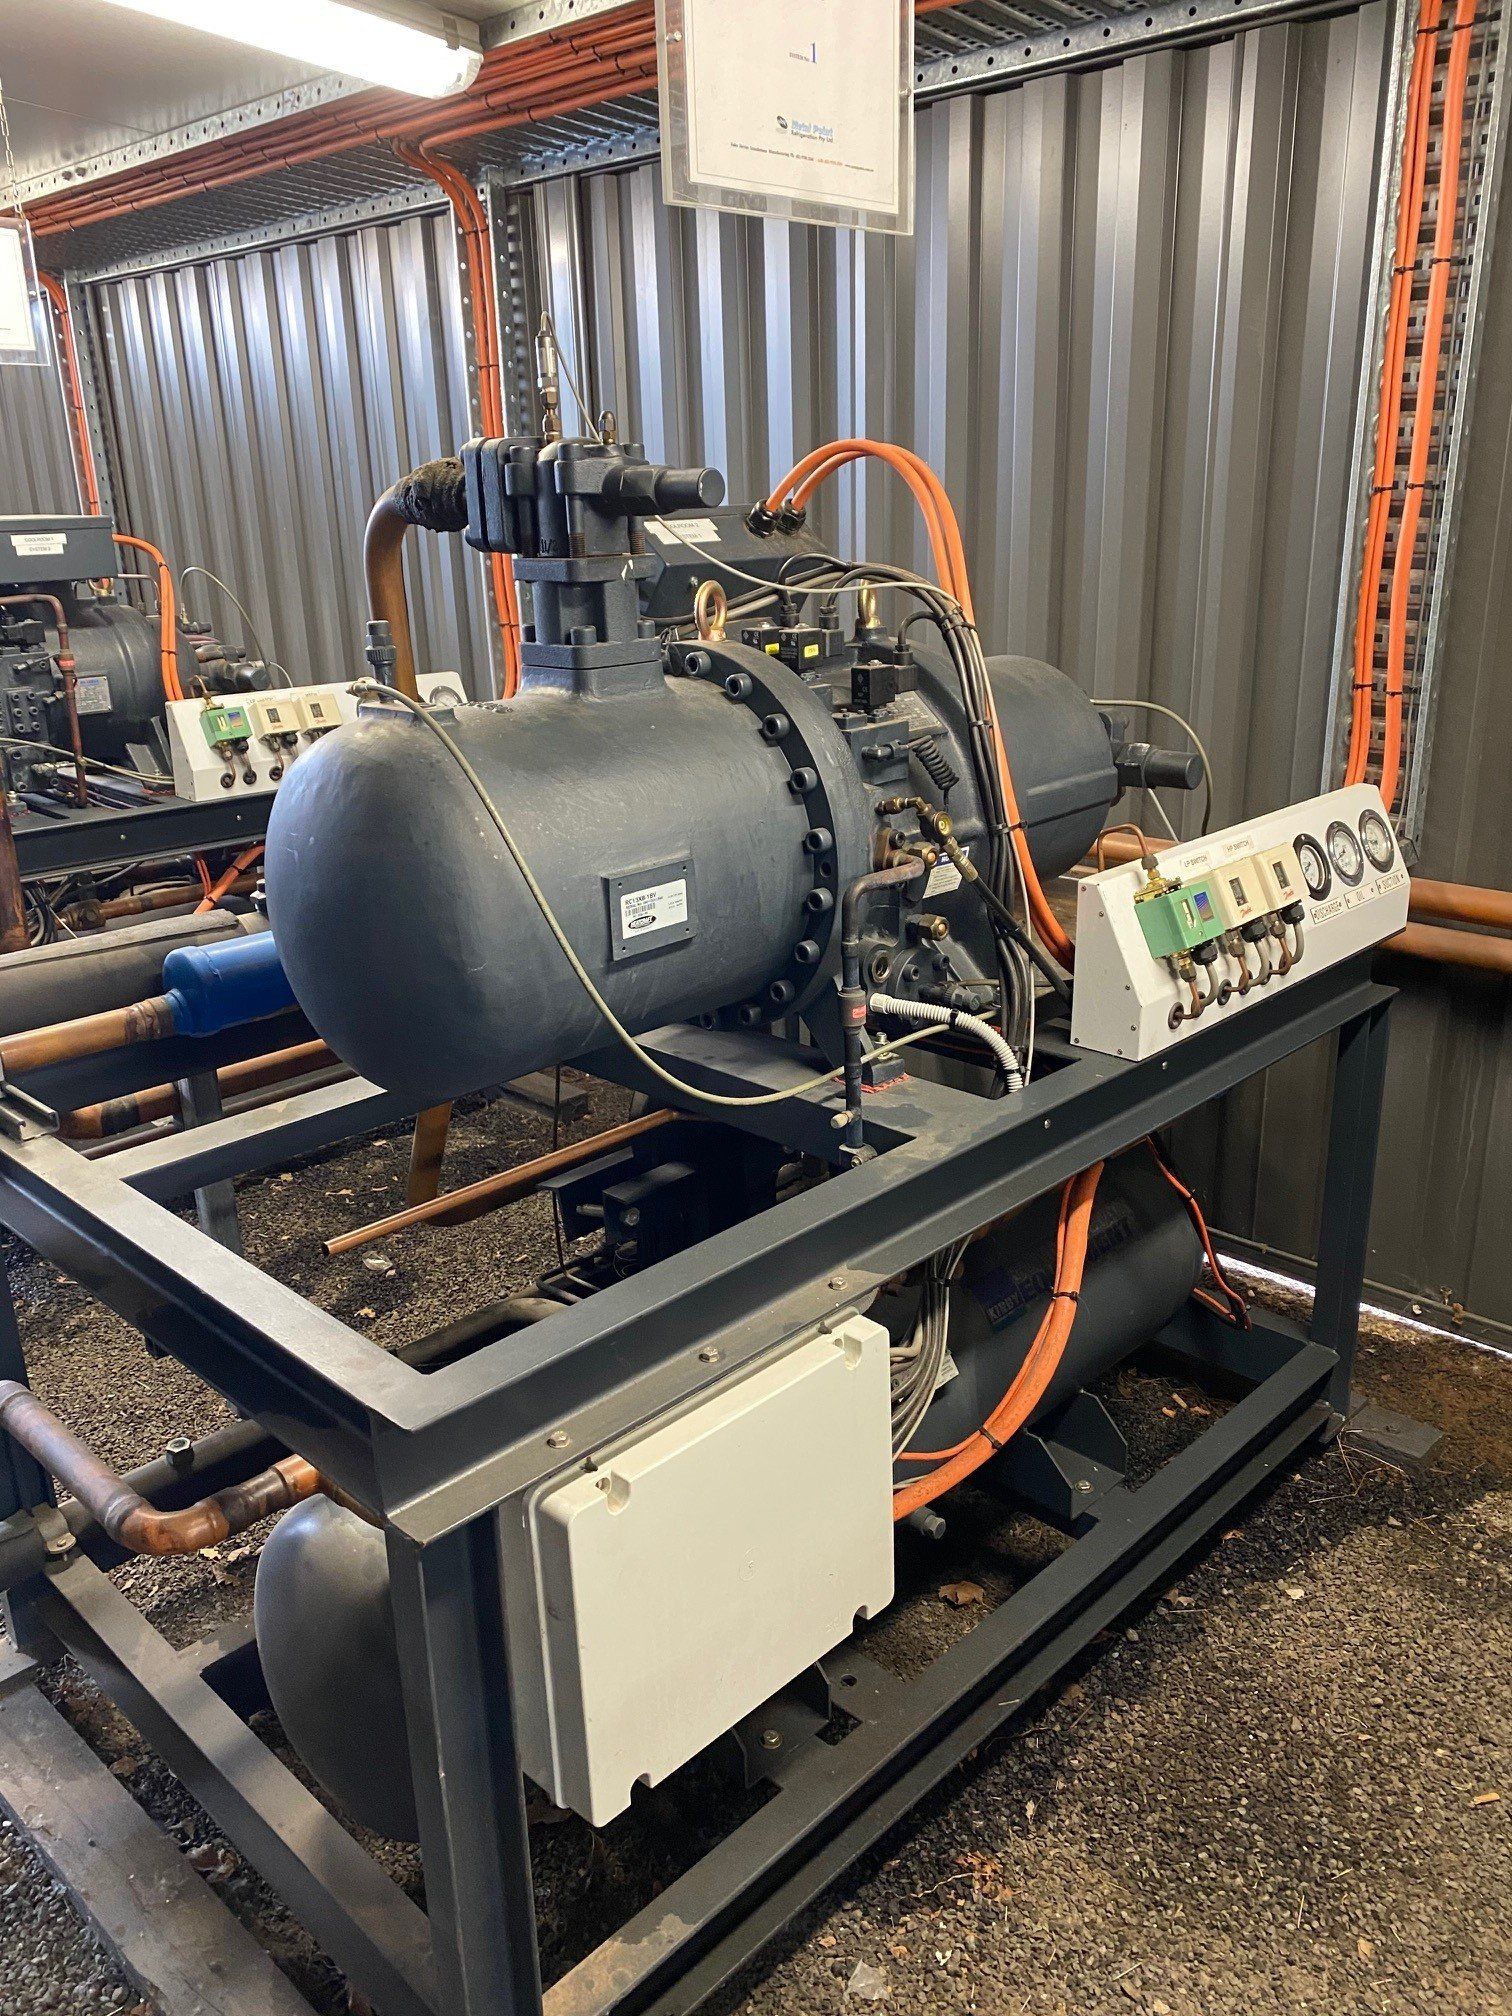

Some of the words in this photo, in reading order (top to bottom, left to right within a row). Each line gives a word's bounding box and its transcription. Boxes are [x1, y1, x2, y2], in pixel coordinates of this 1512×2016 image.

[810, 42, 817, 64] 1
[1233, 839, 1249, 851] SWITCH
[1191, 854, 1208, 866] SWITCH
[1382, 875, 1400, 889] SUCTION
[1314, 900, 1340, 920] DISCHARGE
